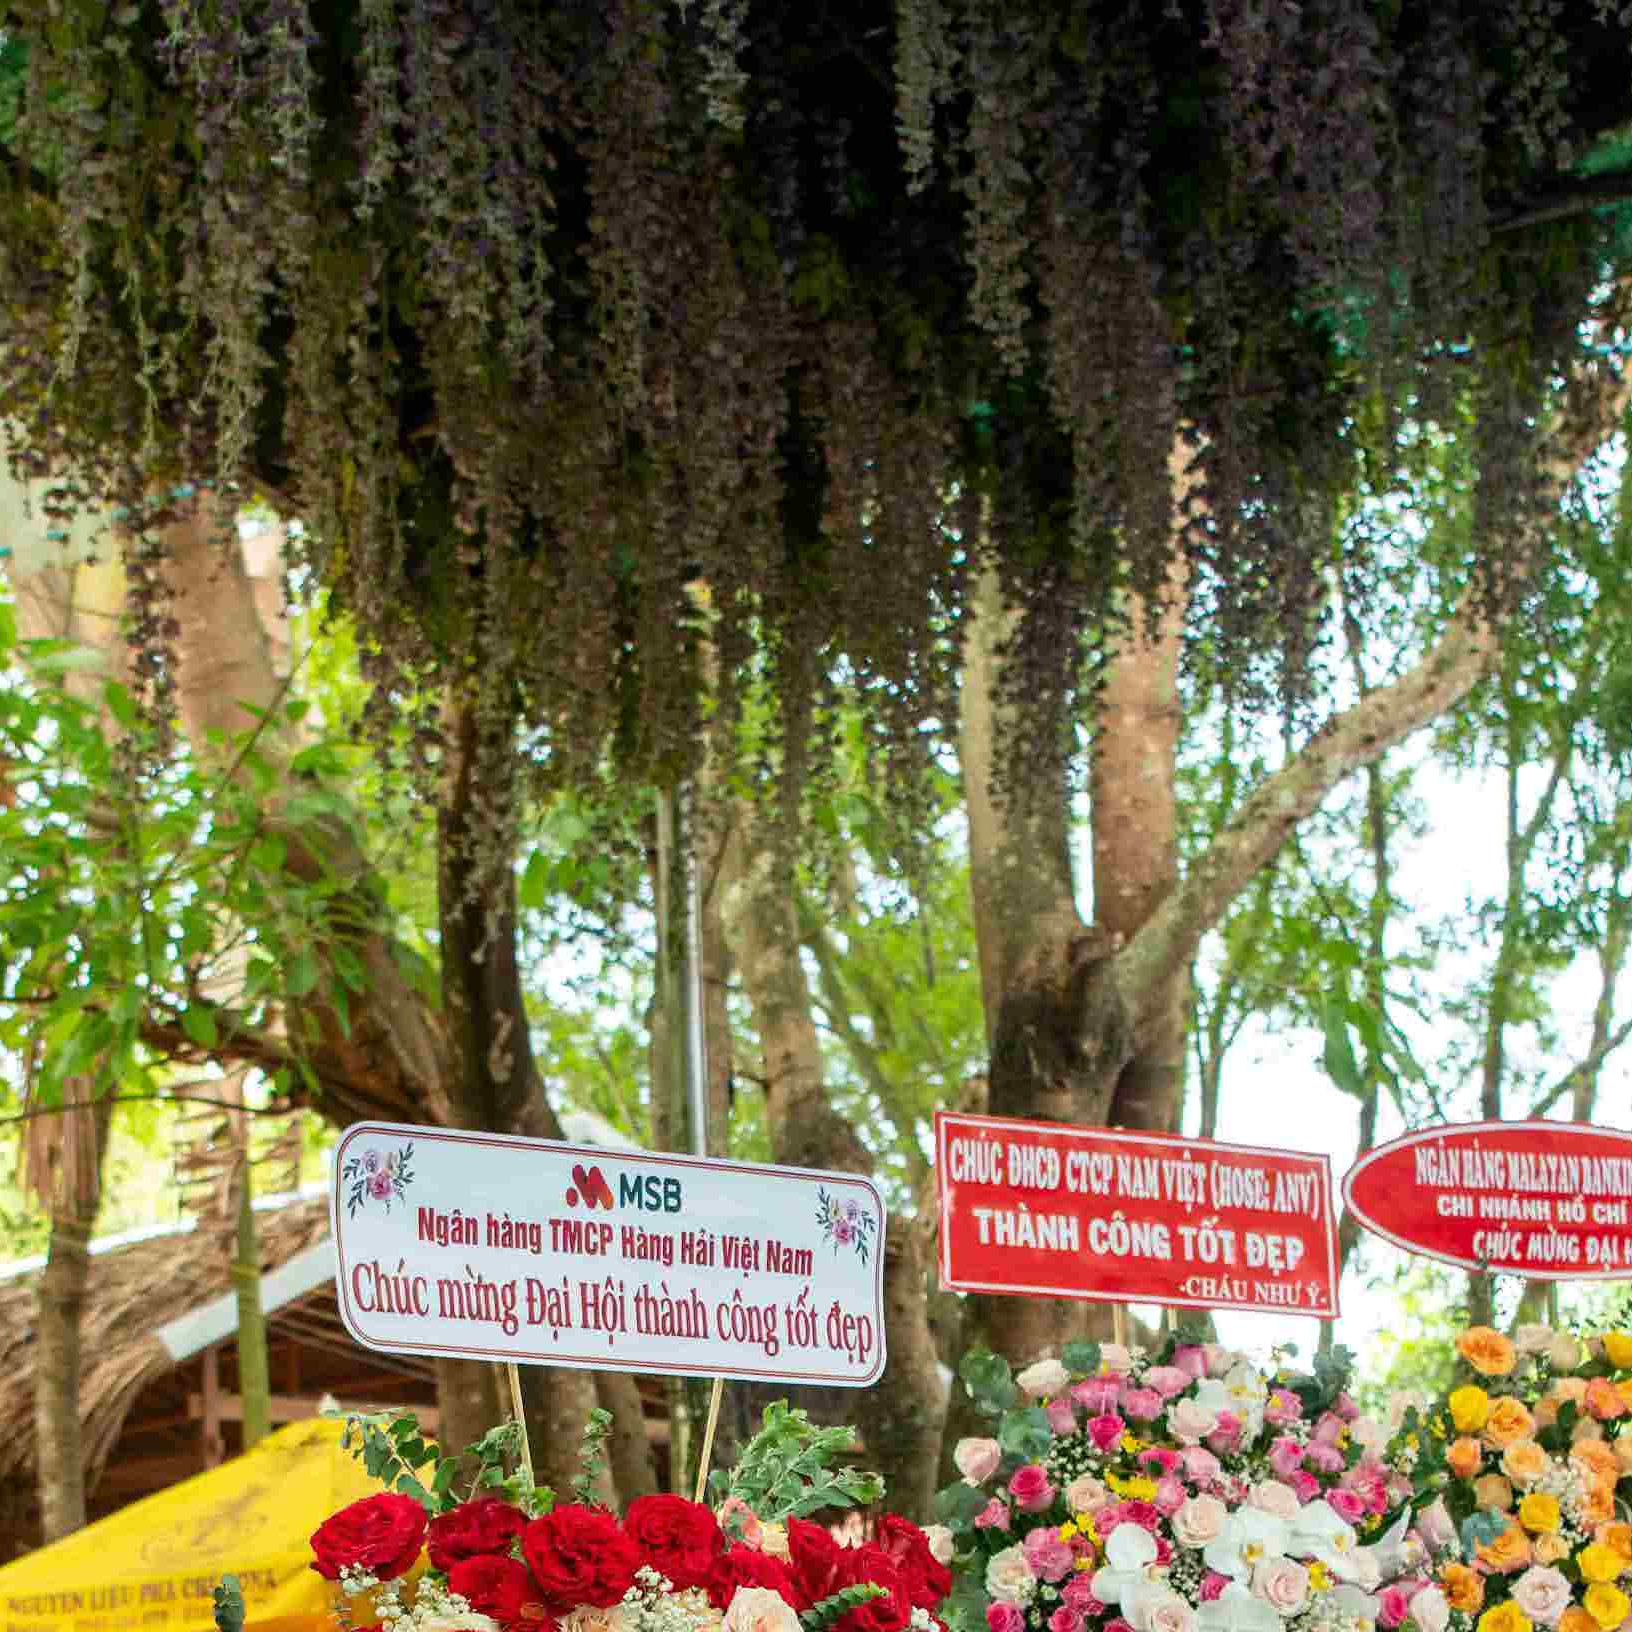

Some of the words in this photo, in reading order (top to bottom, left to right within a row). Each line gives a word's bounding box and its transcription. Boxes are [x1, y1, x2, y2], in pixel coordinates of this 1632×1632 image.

[950, 1131, 1004, 1183] CHÚC
[1067, 1152, 1113, 1196] CTCP
[1118, 1155, 1160, 1201] NAM
[1163, 1149, 1208, 1213] VIỆT
[1273, 1169, 1320, 1221] ANV)
[1414, 1137, 1460, 1188] NGÂN
[1462, 1138, 1505, 1190] HÀNG
[618, 1174, 683, 1214] MSB
[1437, 1194, 1474, 1217] CHI
[1479, 1193, 1551, 1221] NHÁNH
[1557, 1194, 1586, 1222] HỒ
[417, 1206, 480, 1249] Ngân
[486, 1213, 543, 1255] hàng
[549, 1217, 614, 1258] TMCP
[621, 1225, 674, 1268] Hàng
[680, 1229, 716, 1268] Hải
[722, 1235, 761, 1279] Việt
[766, 1239, 814, 1277] Nam
[972, 1201, 1080, 1252] THÀNH
[1087, 1209, 1172, 1260] CÔNG
[1178, 1215, 1237, 1266] TỐT
[1245, 1233, 1305, 1278] ĐẸP
[1472, 1221, 1522, 1261] CHÚC
[1527, 1223, 1579, 1263] MỪNG
[1585, 1235, 1618, 1270] ĐẠI
[351, 1257, 430, 1317] Chúc
[437, 1263, 519, 1337] mừng
[525, 1274, 572, 1342] Đại
[579, 1275, 627, 1345] Hội
[634, 1280, 709, 1341] thành
[716, 1287, 778, 1357] công
[785, 1285, 820, 1348] tốt
[826, 1297, 874, 1364] đẹp
[1254, 1278, 1302, 1306] NHƯ
